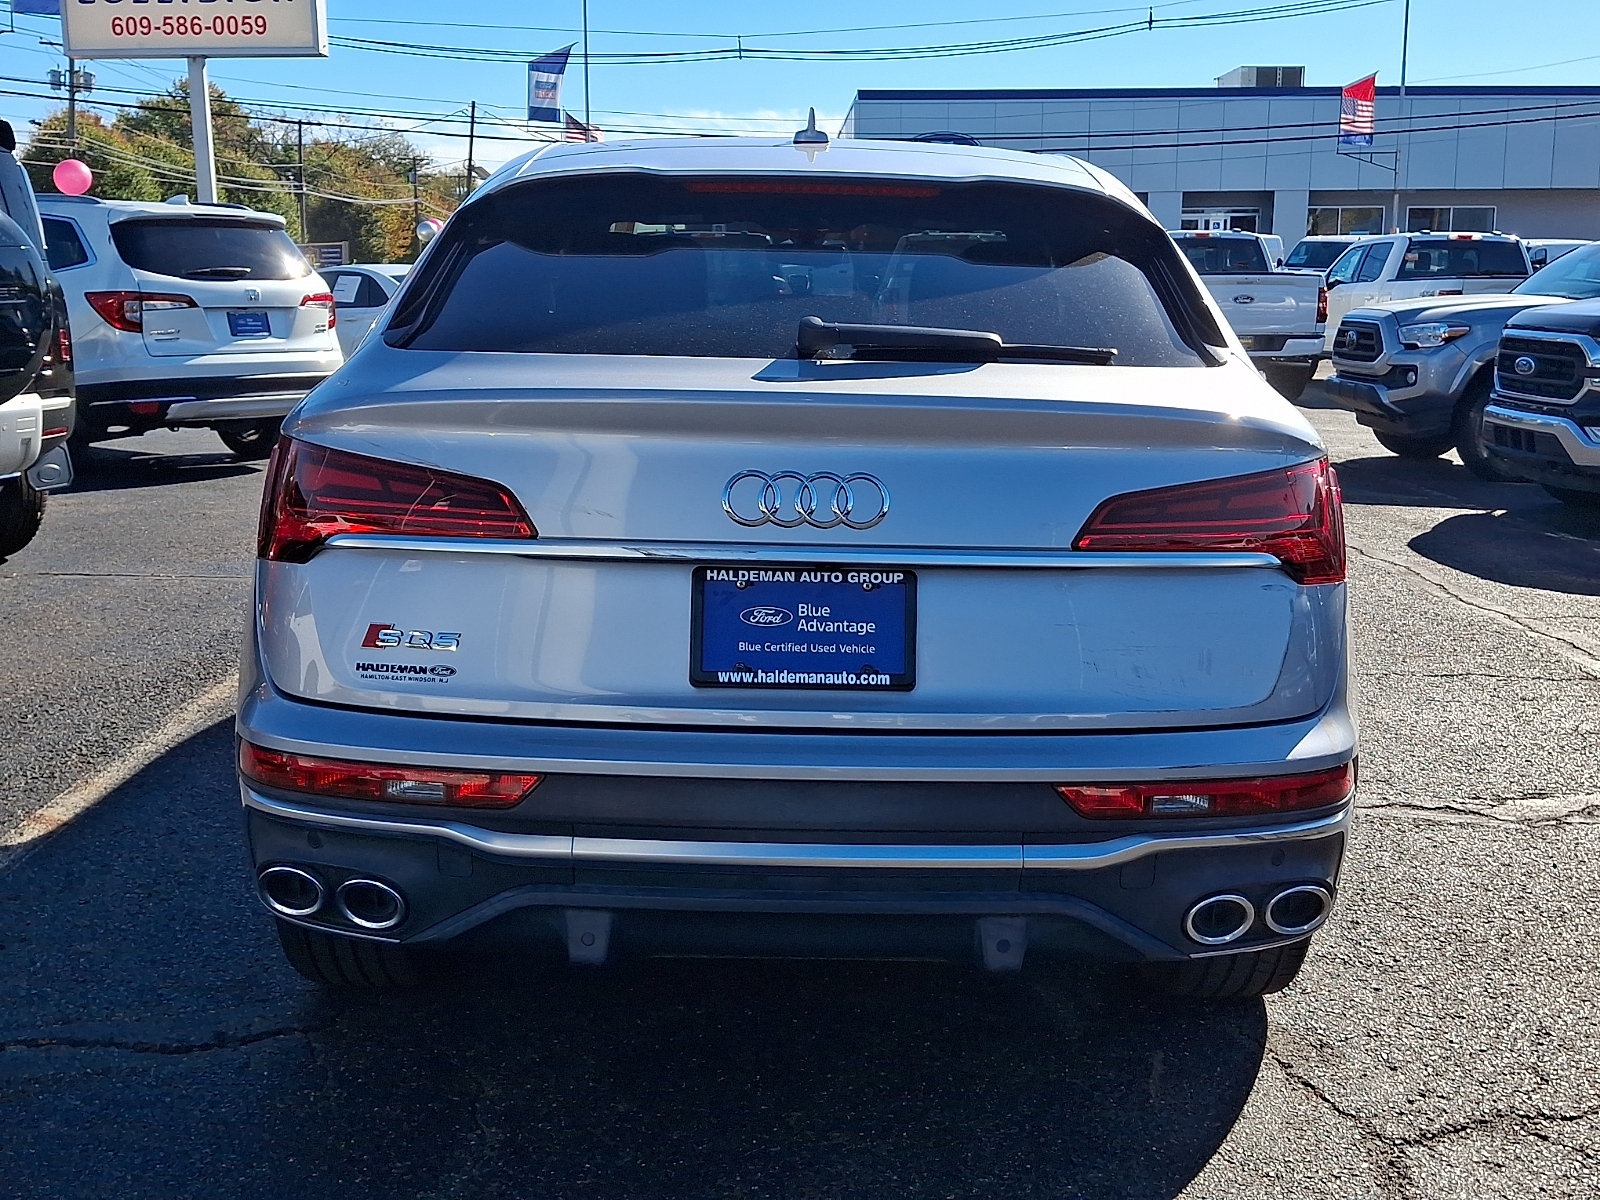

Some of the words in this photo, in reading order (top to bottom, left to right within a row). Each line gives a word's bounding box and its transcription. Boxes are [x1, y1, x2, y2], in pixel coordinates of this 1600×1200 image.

[111, 15, 268, 36] 609-586-0059
[706, 570, 795, 582] HALDEMAN
[799, 572, 843, 583] AUTO
[847, 572, 904, 583] GROUP
[749, 609, 783, 624] Ford
[798, 604, 831, 617] Blue
[797, 619, 876, 635] Advantage
[376, 629, 461, 652] SQ5
[738, 642, 761, 651] Blue
[764, 642, 806, 652] Certified
[810, 643, 836, 653] Used
[839, 644, 876, 654] Vehicle
[355, 662, 428, 675] HALDEMAN
[717, 669, 890, 685] www.haldemanauto.com
